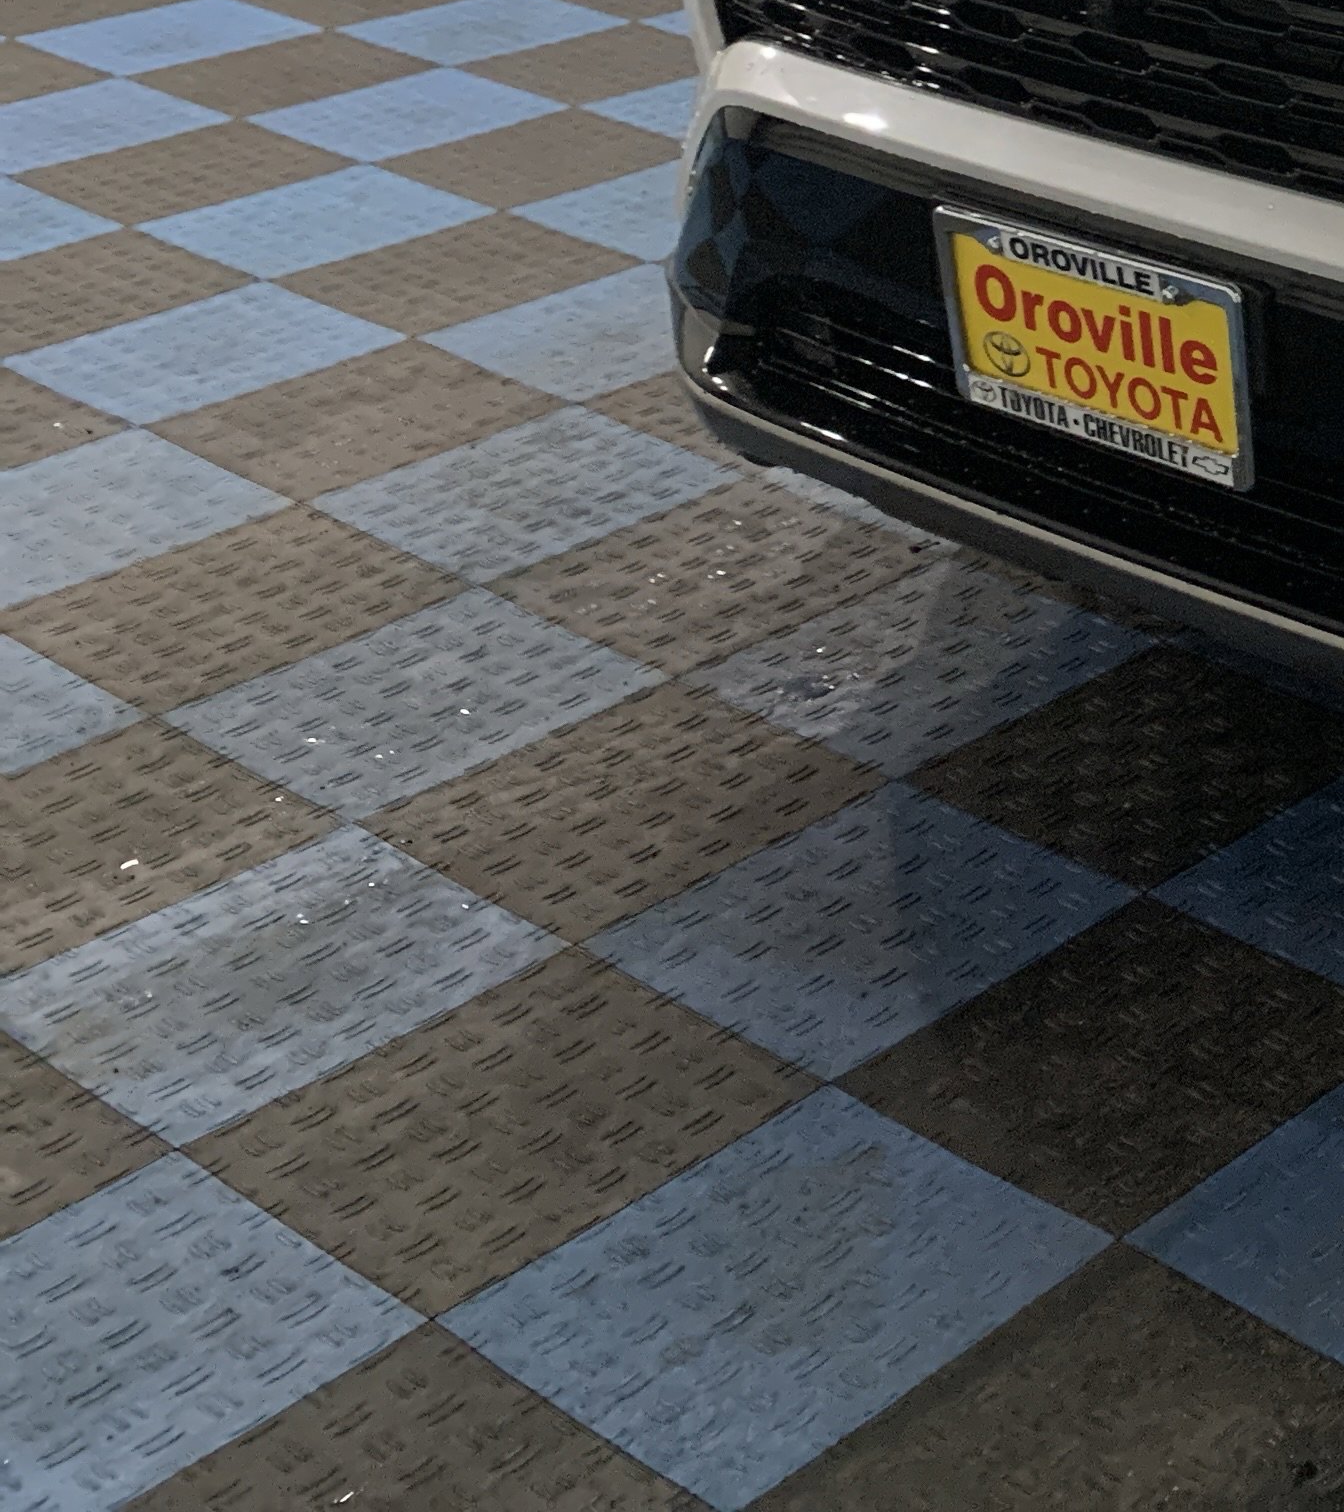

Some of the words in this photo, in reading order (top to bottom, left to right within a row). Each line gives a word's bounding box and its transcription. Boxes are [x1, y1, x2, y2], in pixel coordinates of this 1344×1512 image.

[1009, 238, 1154, 295] OROVILLE
[974, 264, 1218, 385] Oroville
[1000, 386, 1069, 428] TOYOTA
[1083, 414, 1190, 468] CHEVROLET
[1035, 347, 1223, 442] TOYOTA
